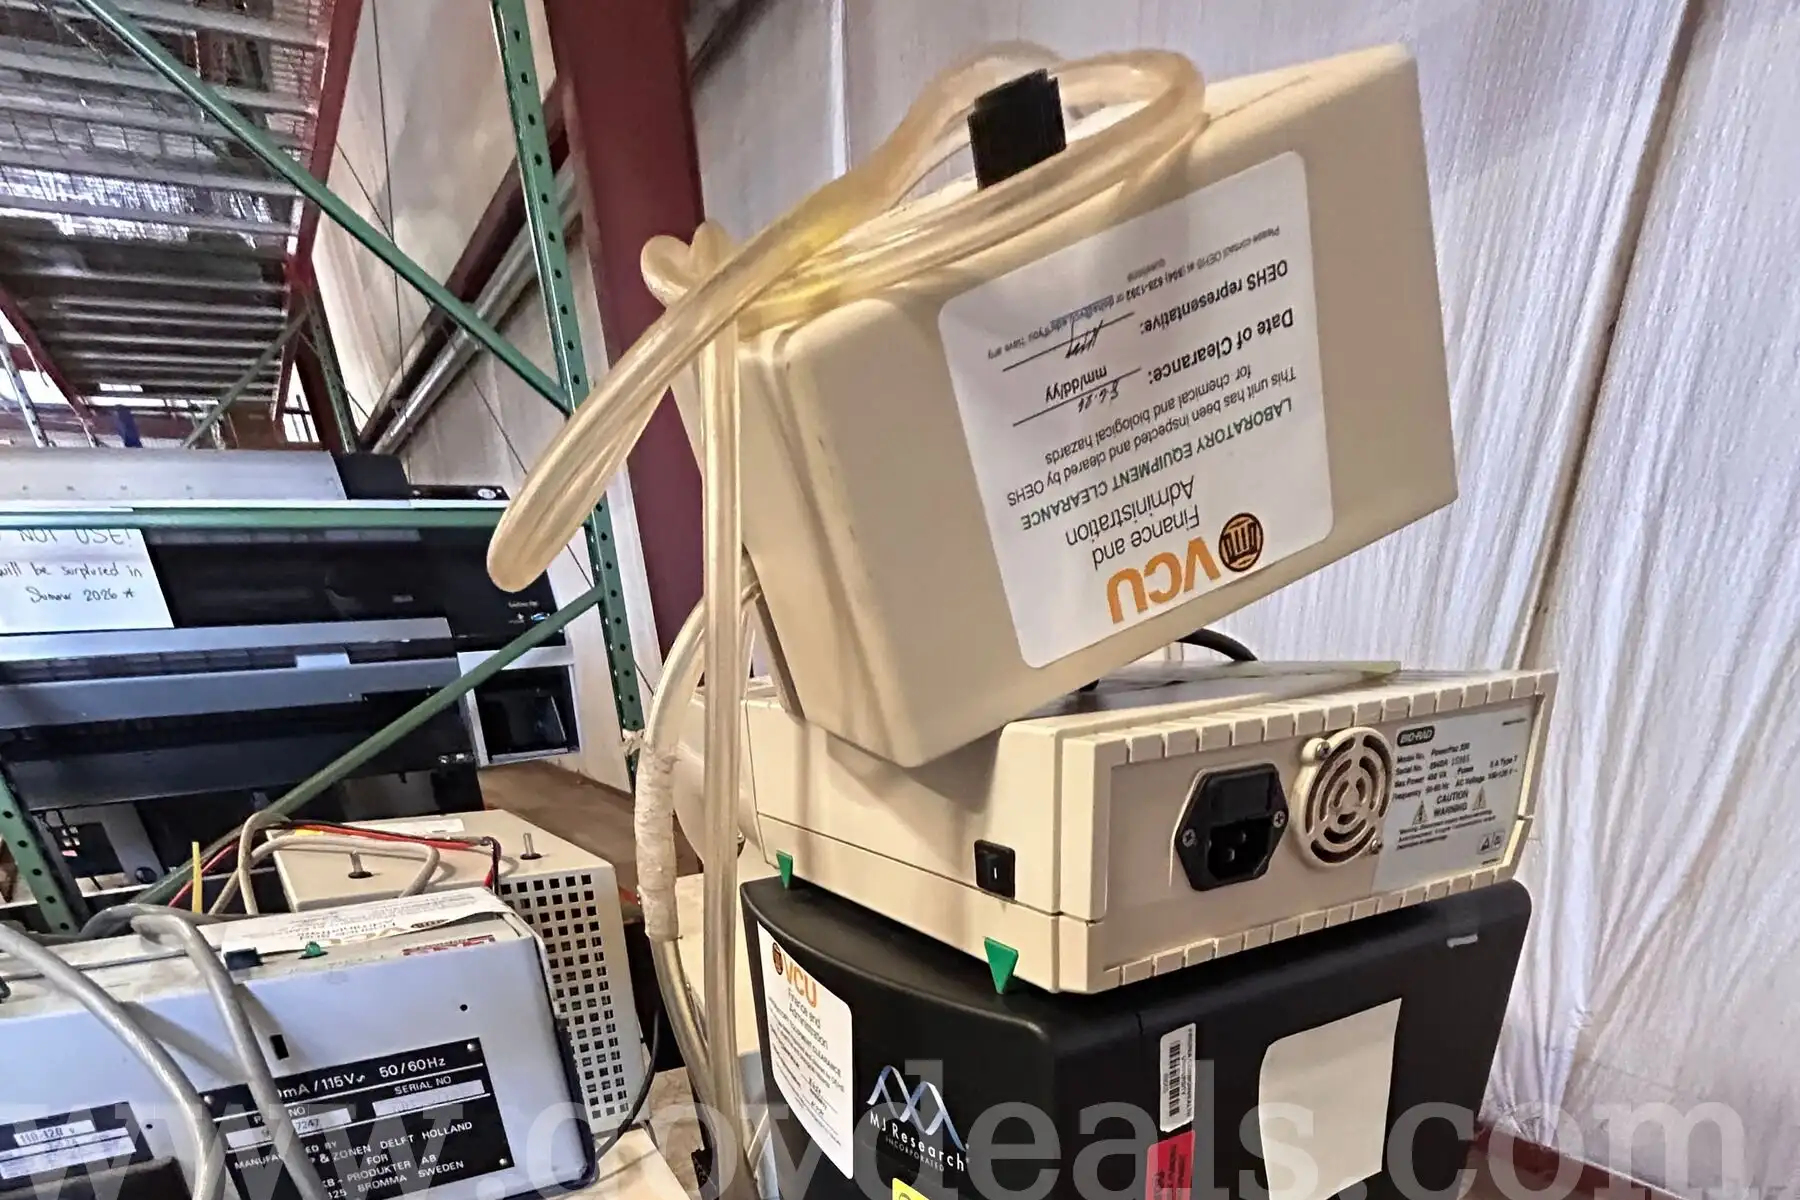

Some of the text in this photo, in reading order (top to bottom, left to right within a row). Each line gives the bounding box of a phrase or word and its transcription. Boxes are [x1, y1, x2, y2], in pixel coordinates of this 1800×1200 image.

[1247, 259, 1288, 291] OEHS
[1140, 277, 1243, 335] representative:
[1149, 307, 1293, 384] Date of Clearance:
[1045, 365, 1108, 401] mm/dd/yy
[1045, 364, 1252, 465] for chemical and biological hazards
[1007, 367, 1296, 506] This unit has been inspected and cleared by OEHS
[1021, 397, 1292, 530] LABORATORY EQUIPMENT CLEARANCE
[1066, 475, 1195, 546] Administration
[74, 529, 131, 547] USE!
[1092, 504, 1199, 570] Finance and
[0, 561, 22, 577] will
[31, 562, 51, 577] be
[127, 564, 143, 578] in
[1107, 537, 1221, 624] VCU
[83, 589, 118, 602] 2026
[1399, 728, 1433, 745] BIO-RAD
[1437, 789, 1469, 804] CAUTION
[783, 953, 817, 1008] VCU
[394, 1080, 434, 1096] SERIAL
[436, 1075, 452, 1087] NO
[334, 1145, 371, 1162] ZONEN
[380, 1134, 414, 1149] DELFT
[422, 1121, 472, 1140] HOLLAND
[366, 1153, 389, 1165] FOR
[421, 1153, 437, 1165] AB
[885, 1136, 944, 1172] INCORPORATED
[892, 1122, 964, 1171] Research
[357, 1175, 407, 1192] BROMMA
[418, 1160, 464, 1178] SWEDEN
